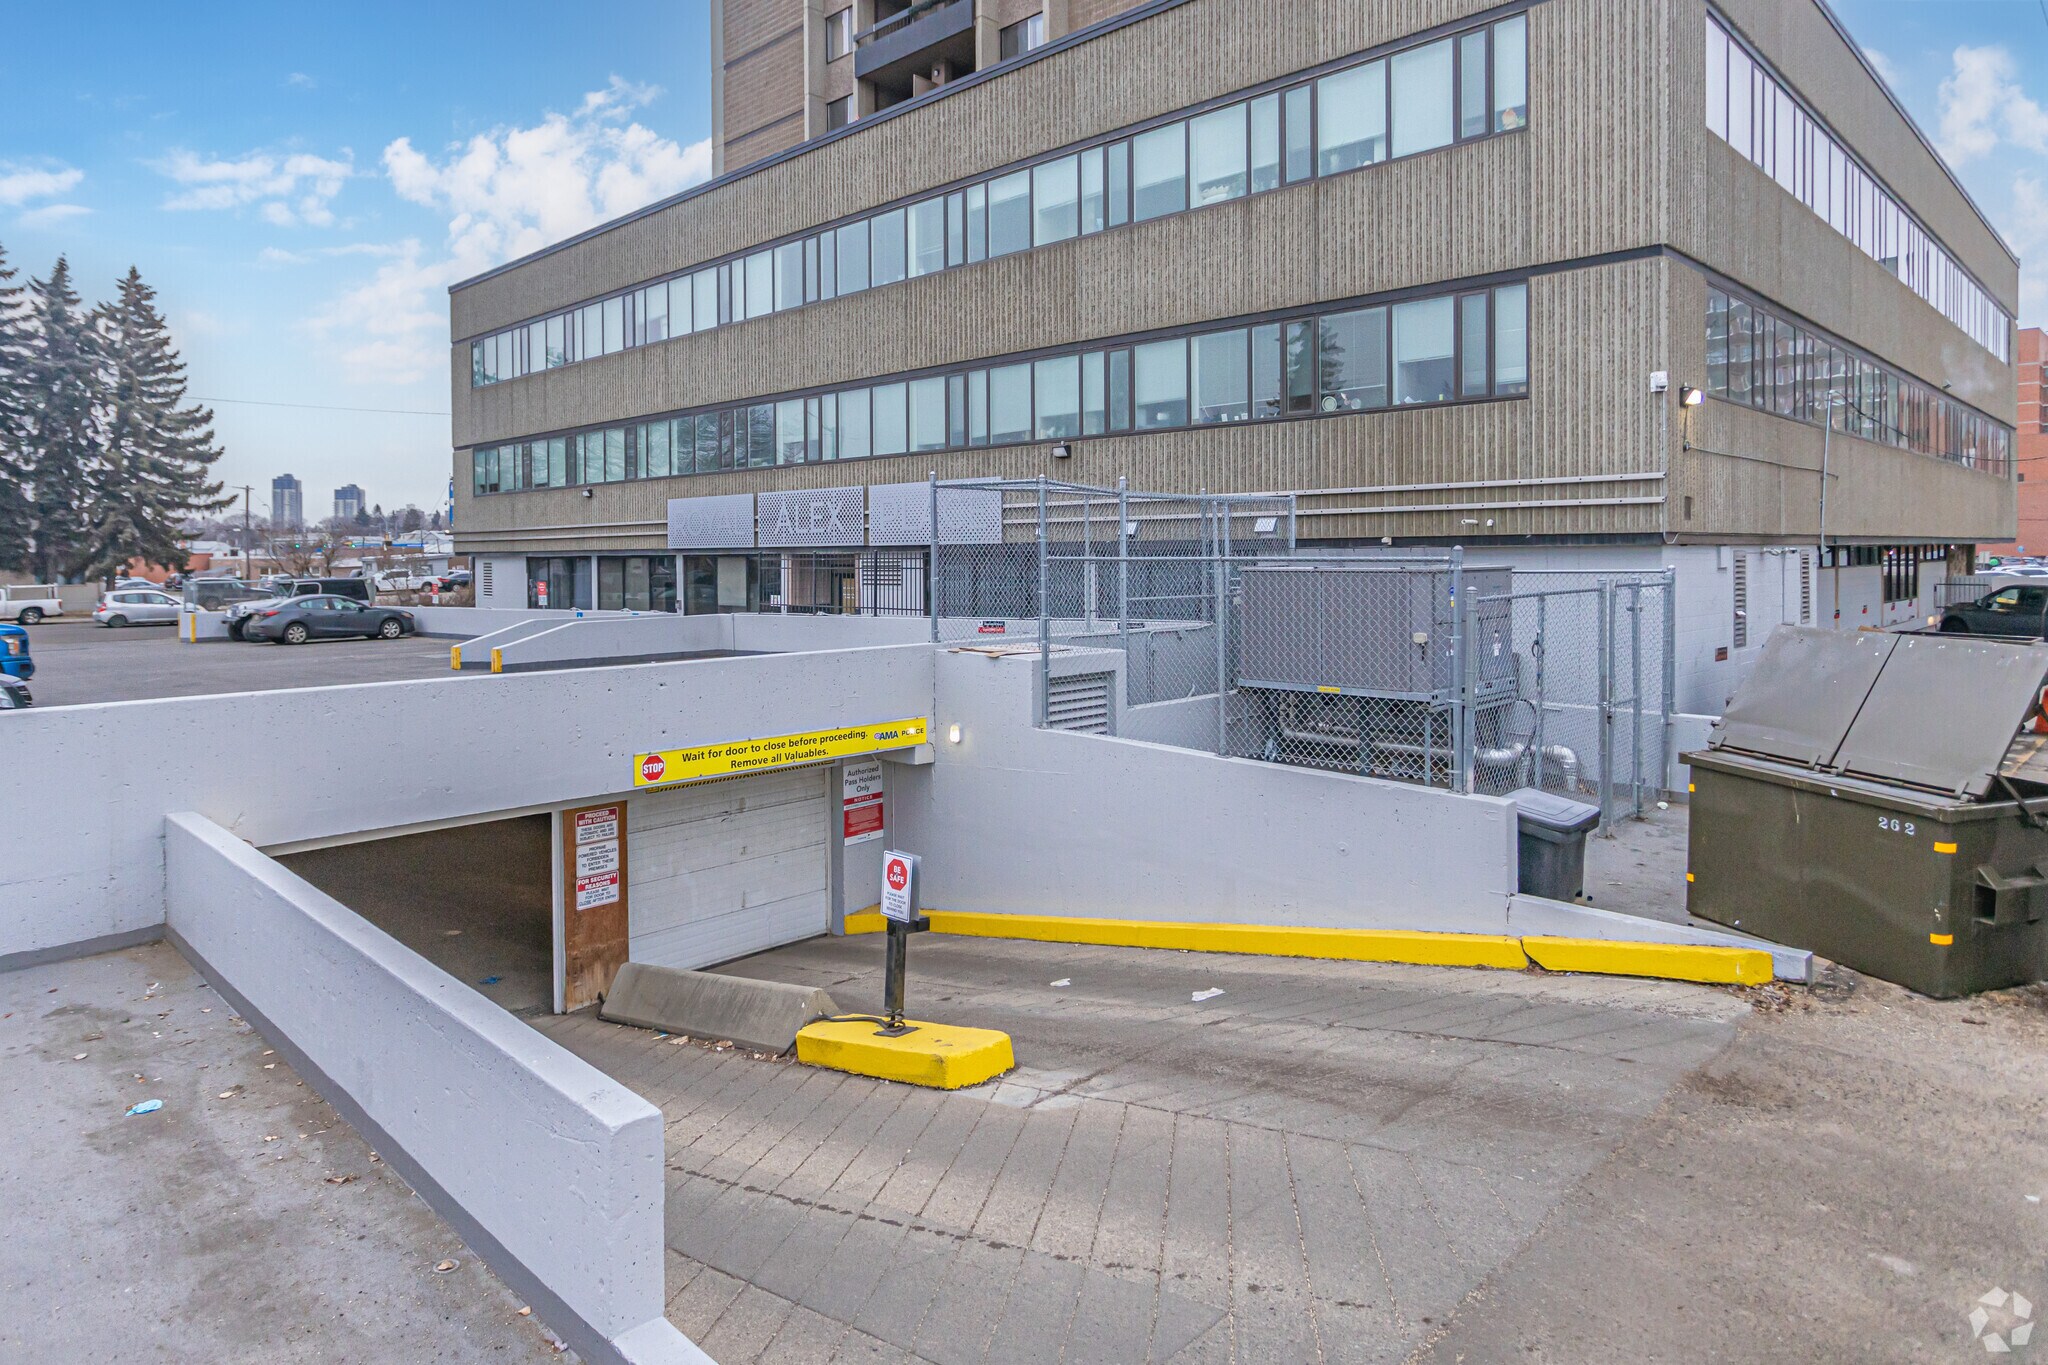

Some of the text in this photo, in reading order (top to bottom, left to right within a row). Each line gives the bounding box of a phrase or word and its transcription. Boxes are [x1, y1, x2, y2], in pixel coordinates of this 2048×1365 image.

[774, 500, 845, 535] ALEX
[879, 730, 899, 740] AMA
[682, 730, 868, 762] Wait for door to close before proceeding.
[730, 747, 829, 769] Remove all Valuables.
[643, 763, 664, 774] STOP
[847, 765, 879, 777] Authorized
[859, 774, 881, 784] Holders
[856, 784, 870, 793] Only
[853, 794, 873, 802] NOTICE
[585, 810, 609, 819] PROCEED
[578, 814, 616, 826] WITH CAUTION
[1878, 816, 1915, 836] 262
[599, 847, 617, 855] VEHICLES
[586, 854, 609, 862] FORBIDDEN
[602, 857, 615, 865] THESE
[588, 864, 608, 872] PREMISES
[893, 865, 901, 873] BE
[578, 872, 617, 885] FOR SECURITY
[889, 873, 905, 884] SAFE
[584, 880, 611, 889] REASONS
